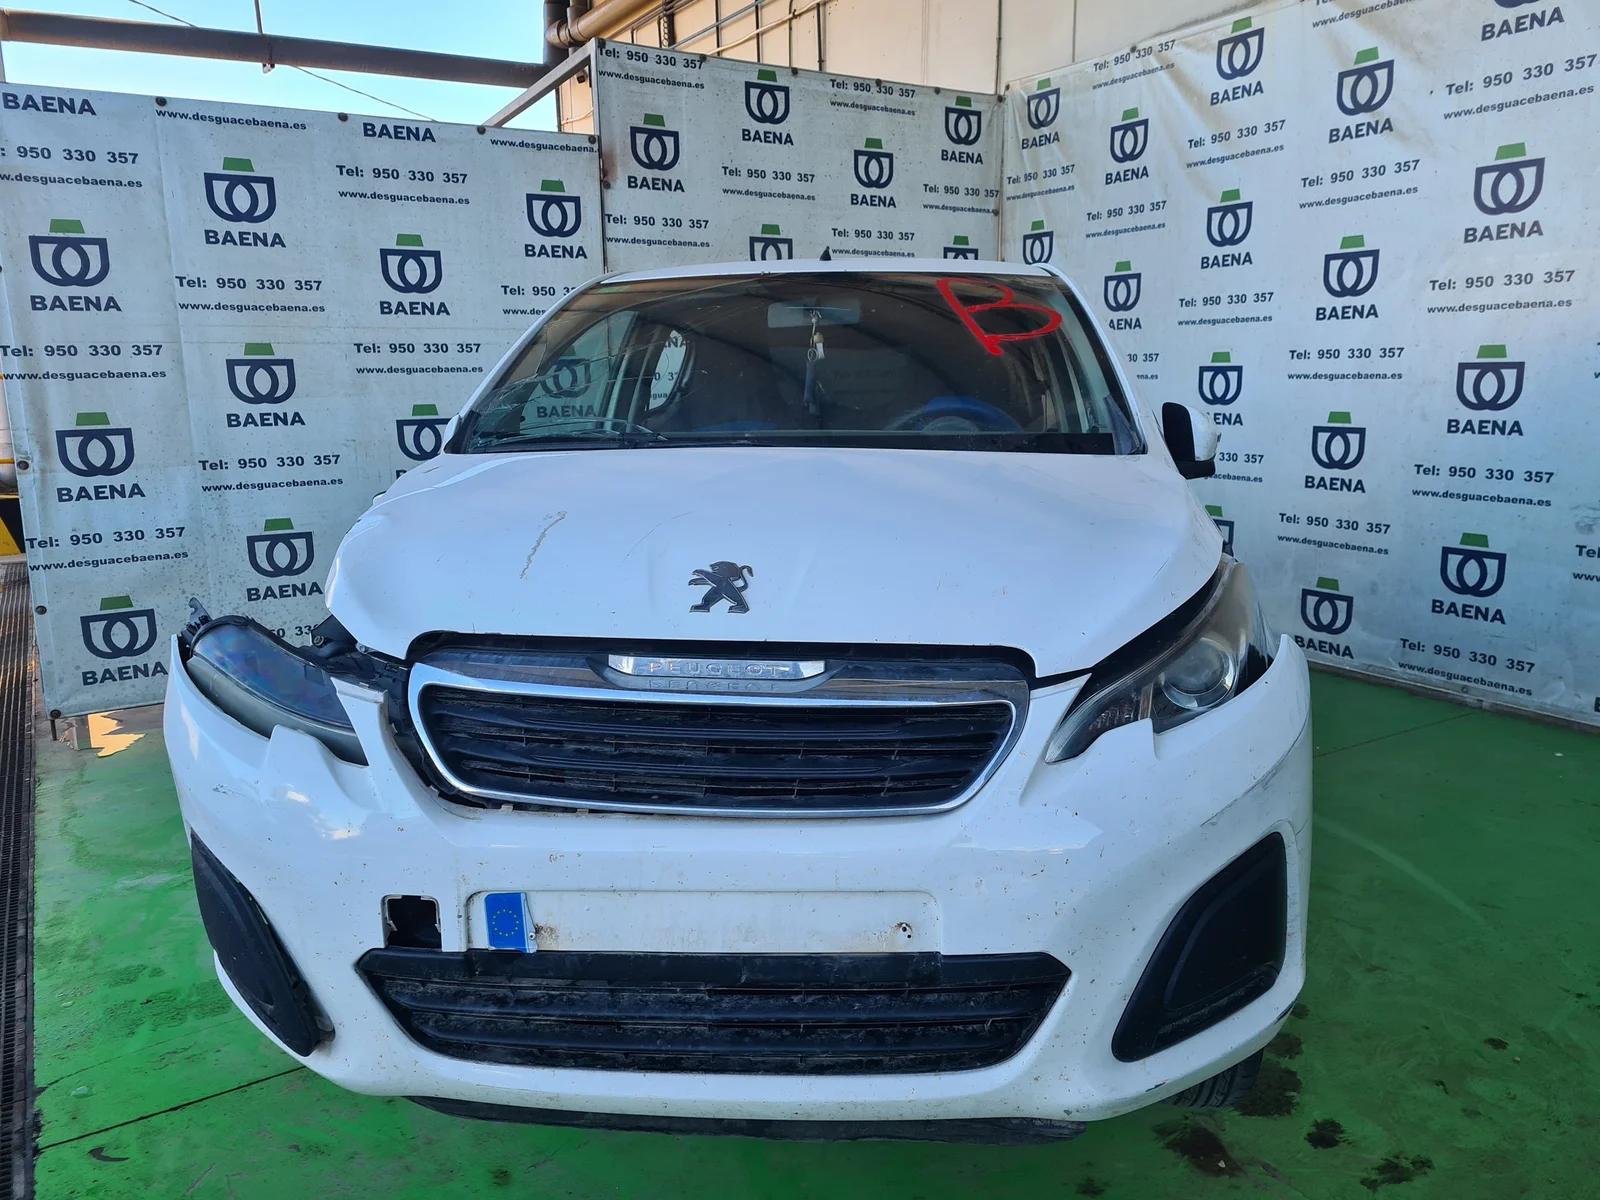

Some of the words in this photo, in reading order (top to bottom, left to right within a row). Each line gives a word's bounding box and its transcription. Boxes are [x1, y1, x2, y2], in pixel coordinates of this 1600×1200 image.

[1481, 7, 1564, 41] BAENA
[627, 51, 648, 62] 950
[656, 55, 676, 66] 330
[683, 58, 704, 70] 357
[1114, 54, 1131, 66] 950
[1136, 46, 1152, 59] 330
[1158, 39, 1176, 53] 357
[599, 70, 704, 90] www.desguacebaena.es
[1446, 81, 1473, 95] Tel:
[1483, 72, 1512, 88] 950
[1523, 63, 1553, 80] 330
[1565, 54, 1597, 72] 357
[830, 79, 847, 89] Tel:
[854, 82, 871, 92] 950
[876, 85, 894, 96] 330
[899, 88, 915, 98] 357
[1210, 81, 1263, 106] BAENA
[2, 93, 96, 115] BAENA
[830, 101, 915, 116] www.desguacebaena.es
[1443, 84, 1594, 120] www.desguacebaena.es
[156, 110, 306, 130] www.desguacebaena.es
[363, 123, 436, 142] BAENA
[742, 129, 794, 145] BAENA
[1188, 137, 1205, 149] Tel:
[1211, 131, 1230, 144] 950
[1237, 126, 1257, 138] 330
[1264, 119, 1285, 133] 357
[1329, 118, 1393, 143] BAENA
[1022, 132, 1060, 150] BAENA
[17, 146, 51, 159] 950
[63, 149, 96, 161] 330
[107, 152, 138, 164] 357
[941, 149, 983, 164] BAENA
[1186, 144, 1284, 168] www.desguacebaena.es
[336, 165, 363, 177] Tel:
[373, 168, 399, 179] 950
[409, 170, 434, 181] 330
[443, 173, 467, 183] 357
[722, 166, 741, 176] Tel:
[747, 169, 766, 179] 950
[773, 171, 791, 181] 330
[797, 173, 815, 183] 357
[1043, 168, 1057, 179] 330
[1061, 164, 1075, 175] 357
[1105, 166, 1148, 185] BAENA
[1301, 176, 1323, 187] Tel:
[1331, 170, 1353, 183] 950
[1362, 165, 1386, 178] 330
[1394, 159, 1420, 173] 357
[628, 176, 685, 192] BAENA
[923, 184, 939, 193] Tel:
[944, 186, 959, 195] 950
[965, 188, 980, 196] 330
[985, 189, 1001, 198] 357
[339, 191, 469, 204] www.desguacebaena.es
[722, 189, 815, 200] www.desguacebaena.es
[851, 194, 896, 208] BAENA
[1299, 187, 1418, 208] www.desguacebaena.es
[1087, 211, 1102, 221] Tel:
[1107, 208, 1123, 218] 950
[1128, 204, 1144, 215] 330
[1150, 200, 1166, 211] 357
[606, 214, 626, 225] Tel:
[634, 216, 655, 226] 950
[662, 218, 682, 227] 330
[689, 219, 709, 229] 357
[204, 230, 286, 248] BAENA
[832, 228, 849, 237] Tel:
[855, 230, 871, 238] 950
[877, 231, 893, 239] 330
[899, 232, 914, 241] 357
[1464, 221, 1543, 243] BAENA
[606, 236, 710, 248] www.desguacebaena.es
[525, 244, 587, 259] BAENA
[1201, 252, 1252, 269] BAENA
[175, 276, 206, 288] Tel:
[217, 278, 246, 289] 950
[256, 279, 285, 290] 330
[295, 280, 322, 290] 357
[1430, 279, 1456, 290] Tel:
[1466, 276, 1494, 288] 950
[1504, 273, 1533, 286] 330
[1544, 270, 1575, 283] 357
[501, 285, 524, 295] Tel:
[533, 286, 555, 296] 950
[30, 295, 122, 311] BAENA
[179, 302, 325, 312] www.desguacebaena.es
[380, 301, 450, 315] BAENA
[1179, 298, 1196, 307] Tel:
[1203, 296, 1221, 306] 950
[1228, 294, 1246, 304] 330
[1254, 292, 1273, 302] 357
[1427, 300, 1572, 313] www.desguacebaena.es
[936, 278, 1062, 356] B
[1316, 304, 1378, 320] BAENA
[1178, 316, 1272, 326] www.desguacebaena.es
[0, 345, 33, 356] Tel:
[44, 345, 77, 356] 950
[89, 345, 121, 356] 330
[132, 345, 162, 355] 357
[354, 343, 380, 353] Tel:
[389, 343, 415, 353] 950
[424, 343, 448, 353] 330
[457, 344, 481, 353] 357
[1289, 350, 1310, 359] Tel:
[1318, 349, 1340, 359] 950
[1348, 348, 1371, 358] 330
[1380, 348, 1404, 358] 357
[1143, 353, 1159, 362] 357
[3, 370, 166, 381] www.desguacebaena.es
[356, 366, 483, 375] www.desguacebaena.es
[1288, 372, 1402, 381] www.desguacebaena.es
[227, 412, 305, 427] BAENA
[537, 406, 596, 418] BAENA
[1447, 419, 1523, 436] BAENA
[198, 460, 228, 470] Tel:
[238, 458, 267, 469] 950
[277, 456, 304, 467] 330
[314, 455, 340, 465] 357
[1219, 452, 1238, 462] 330
[1244, 454, 1264, 463] 357
[1414, 464, 1440, 476] Tel:
[1449, 466, 1476, 478] 950
[1485, 469, 1514, 480] 330
[1524, 471, 1554, 483] 357
[57, 483, 146, 502] BAENA
[202, 479, 343, 491] www.desguacebaena.es
[1305, 476, 1365, 493] BAENA
[1412, 490, 1551, 506] www.desguacebaena.es
[1279, 513, 1299, 524] Tel:
[1307, 516, 1328, 527] 950
[1336, 519, 1358, 530] 330
[1367, 523, 1390, 534] 357
[25, 537, 59, 548] Tel:
[70, 533, 102, 545] 950
[113, 530, 144, 542] 330
[155, 527, 185, 538] 357
[1278, 536, 1388, 555] www.desguacebaena.es
[29, 552, 188, 571] www.desguacebaena.es
[247, 582, 323, 601] BAENA
[1432, 599, 1505, 624] BAENA
[1294, 635, 1354, 659] BAENA
[1400, 638, 1425, 652] Tel:
[1434, 645, 1460, 658] 950
[1469, 652, 1496, 666] 330
[1506, 659, 1535, 672] 357
[82, 662, 168, 686] BAENA
[649, 662, 784, 676] PEUGEOT
[1398, 661, 1533, 696] www.desguacebaena.es
